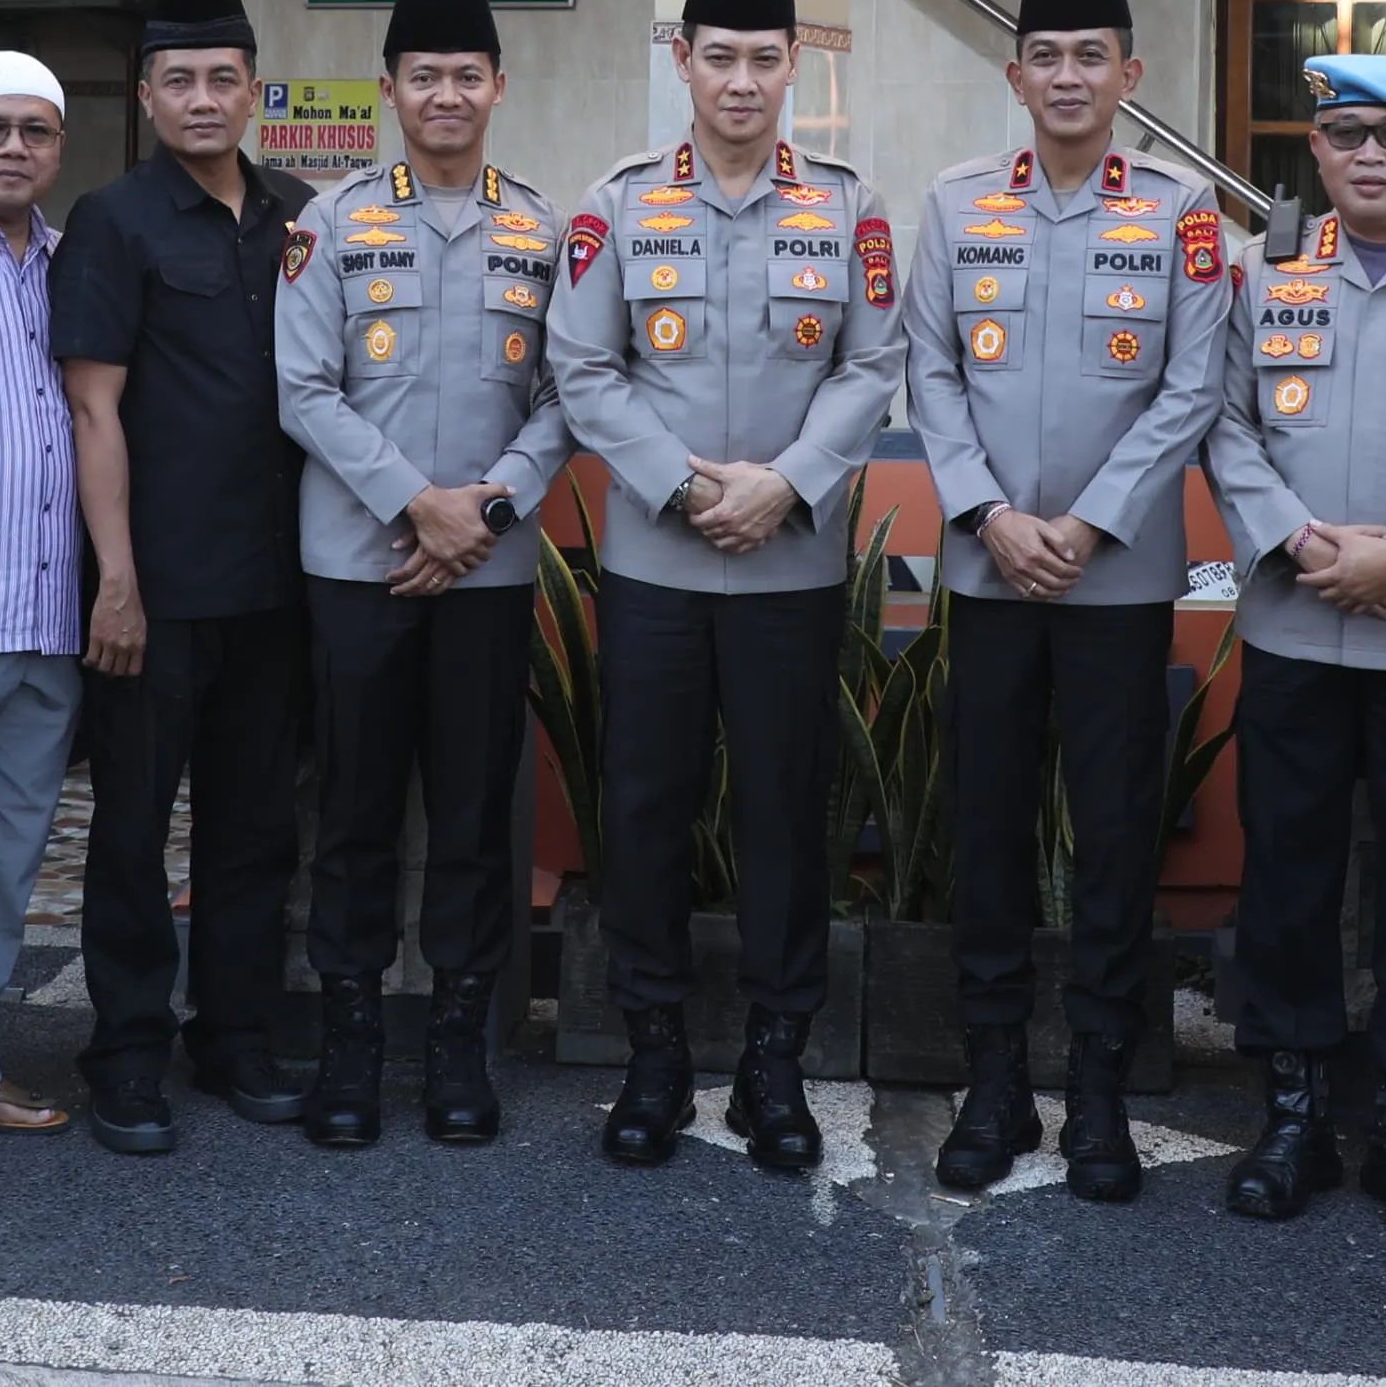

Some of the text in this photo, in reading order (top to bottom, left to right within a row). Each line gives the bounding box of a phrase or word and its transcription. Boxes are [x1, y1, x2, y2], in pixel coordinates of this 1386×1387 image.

[268, 86, 284, 107] P
[293, 105, 373, 120] Mohon Ma'af
[260, 125, 376, 151] PARKIR KHUSUS
[300, 154, 329, 171] Masjid
[1176, 212, 1217, 231] POLDA
[1186, 229, 1214, 238] BALI
[631, 238, 702, 257] DANIEL.A
[774, 239, 840, 258] POLRI
[858, 238, 891, 253] POLDA
[342, 251, 416, 274] SIGIT DANY
[956, 246, 1025, 265] KOMANG
[1094, 253, 1162, 272] POLRI
[487, 255, 552, 282] POLRI
[1259, 308, 1332, 326] AGUS
